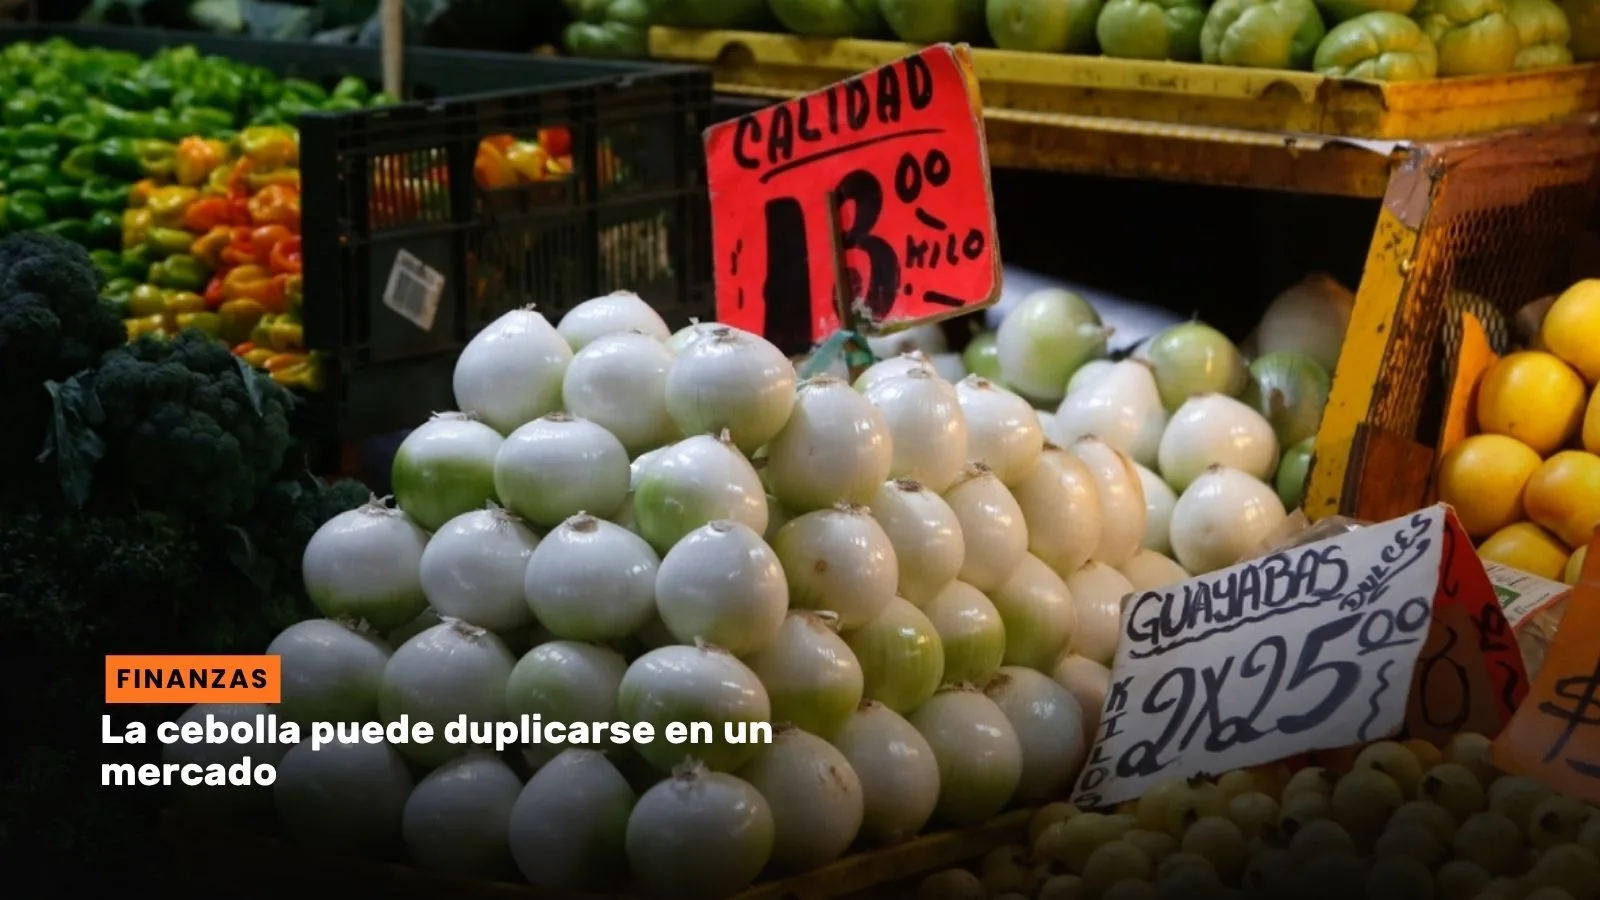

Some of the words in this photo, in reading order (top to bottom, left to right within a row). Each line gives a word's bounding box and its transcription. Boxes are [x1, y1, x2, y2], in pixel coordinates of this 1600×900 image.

[733, 54, 933, 170] CALIDAD
[905, 228, 985, 270] KILO
[1126, 545, 1350, 646] GUAYABAS
[1337, 513, 1433, 612] DULCES
